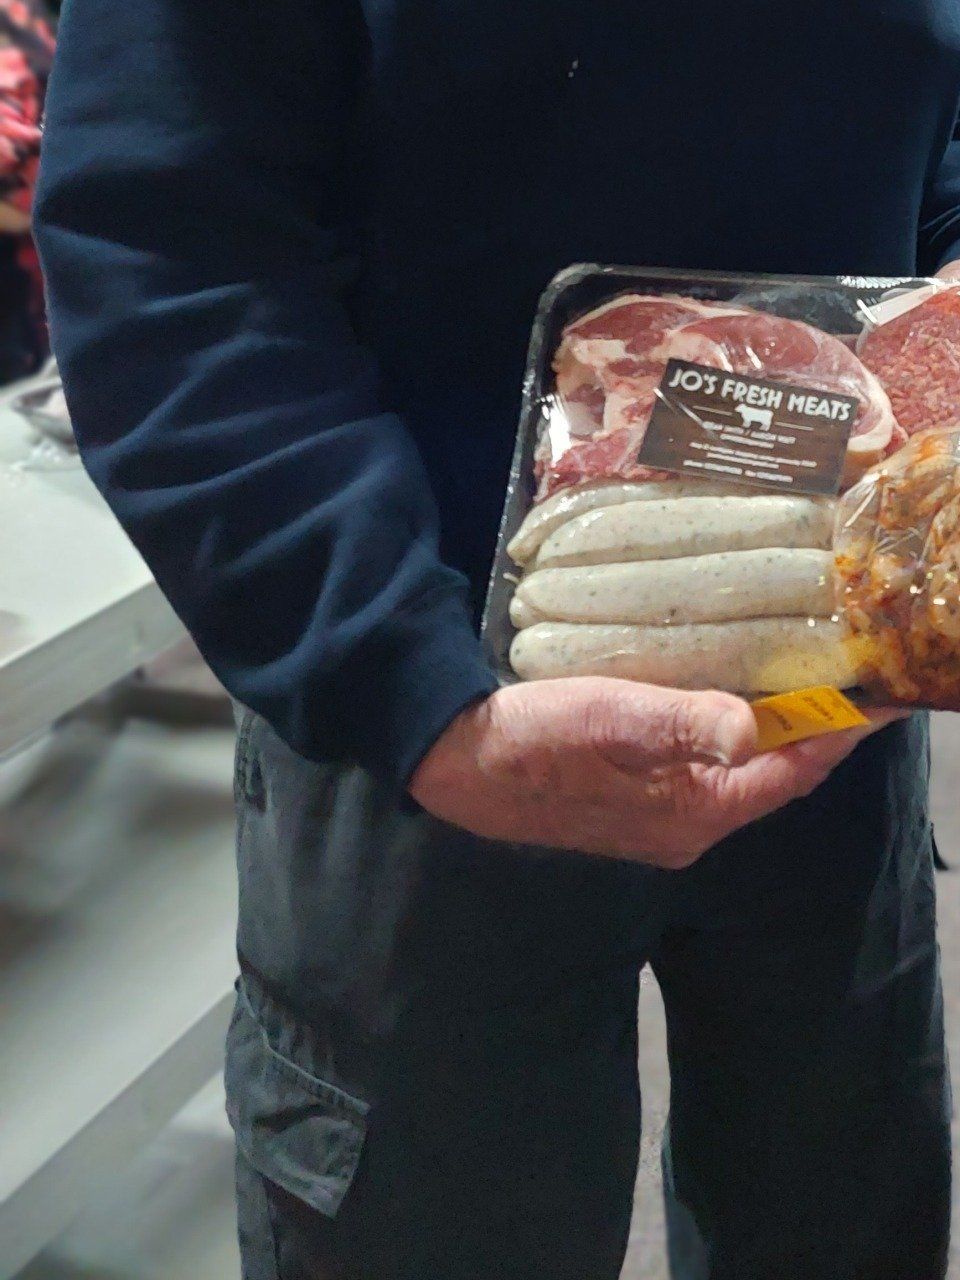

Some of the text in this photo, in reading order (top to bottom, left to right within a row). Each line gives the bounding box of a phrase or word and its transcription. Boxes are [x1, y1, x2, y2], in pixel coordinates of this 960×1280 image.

[668, 368, 852, 421] JO'S FRESH MEATS
